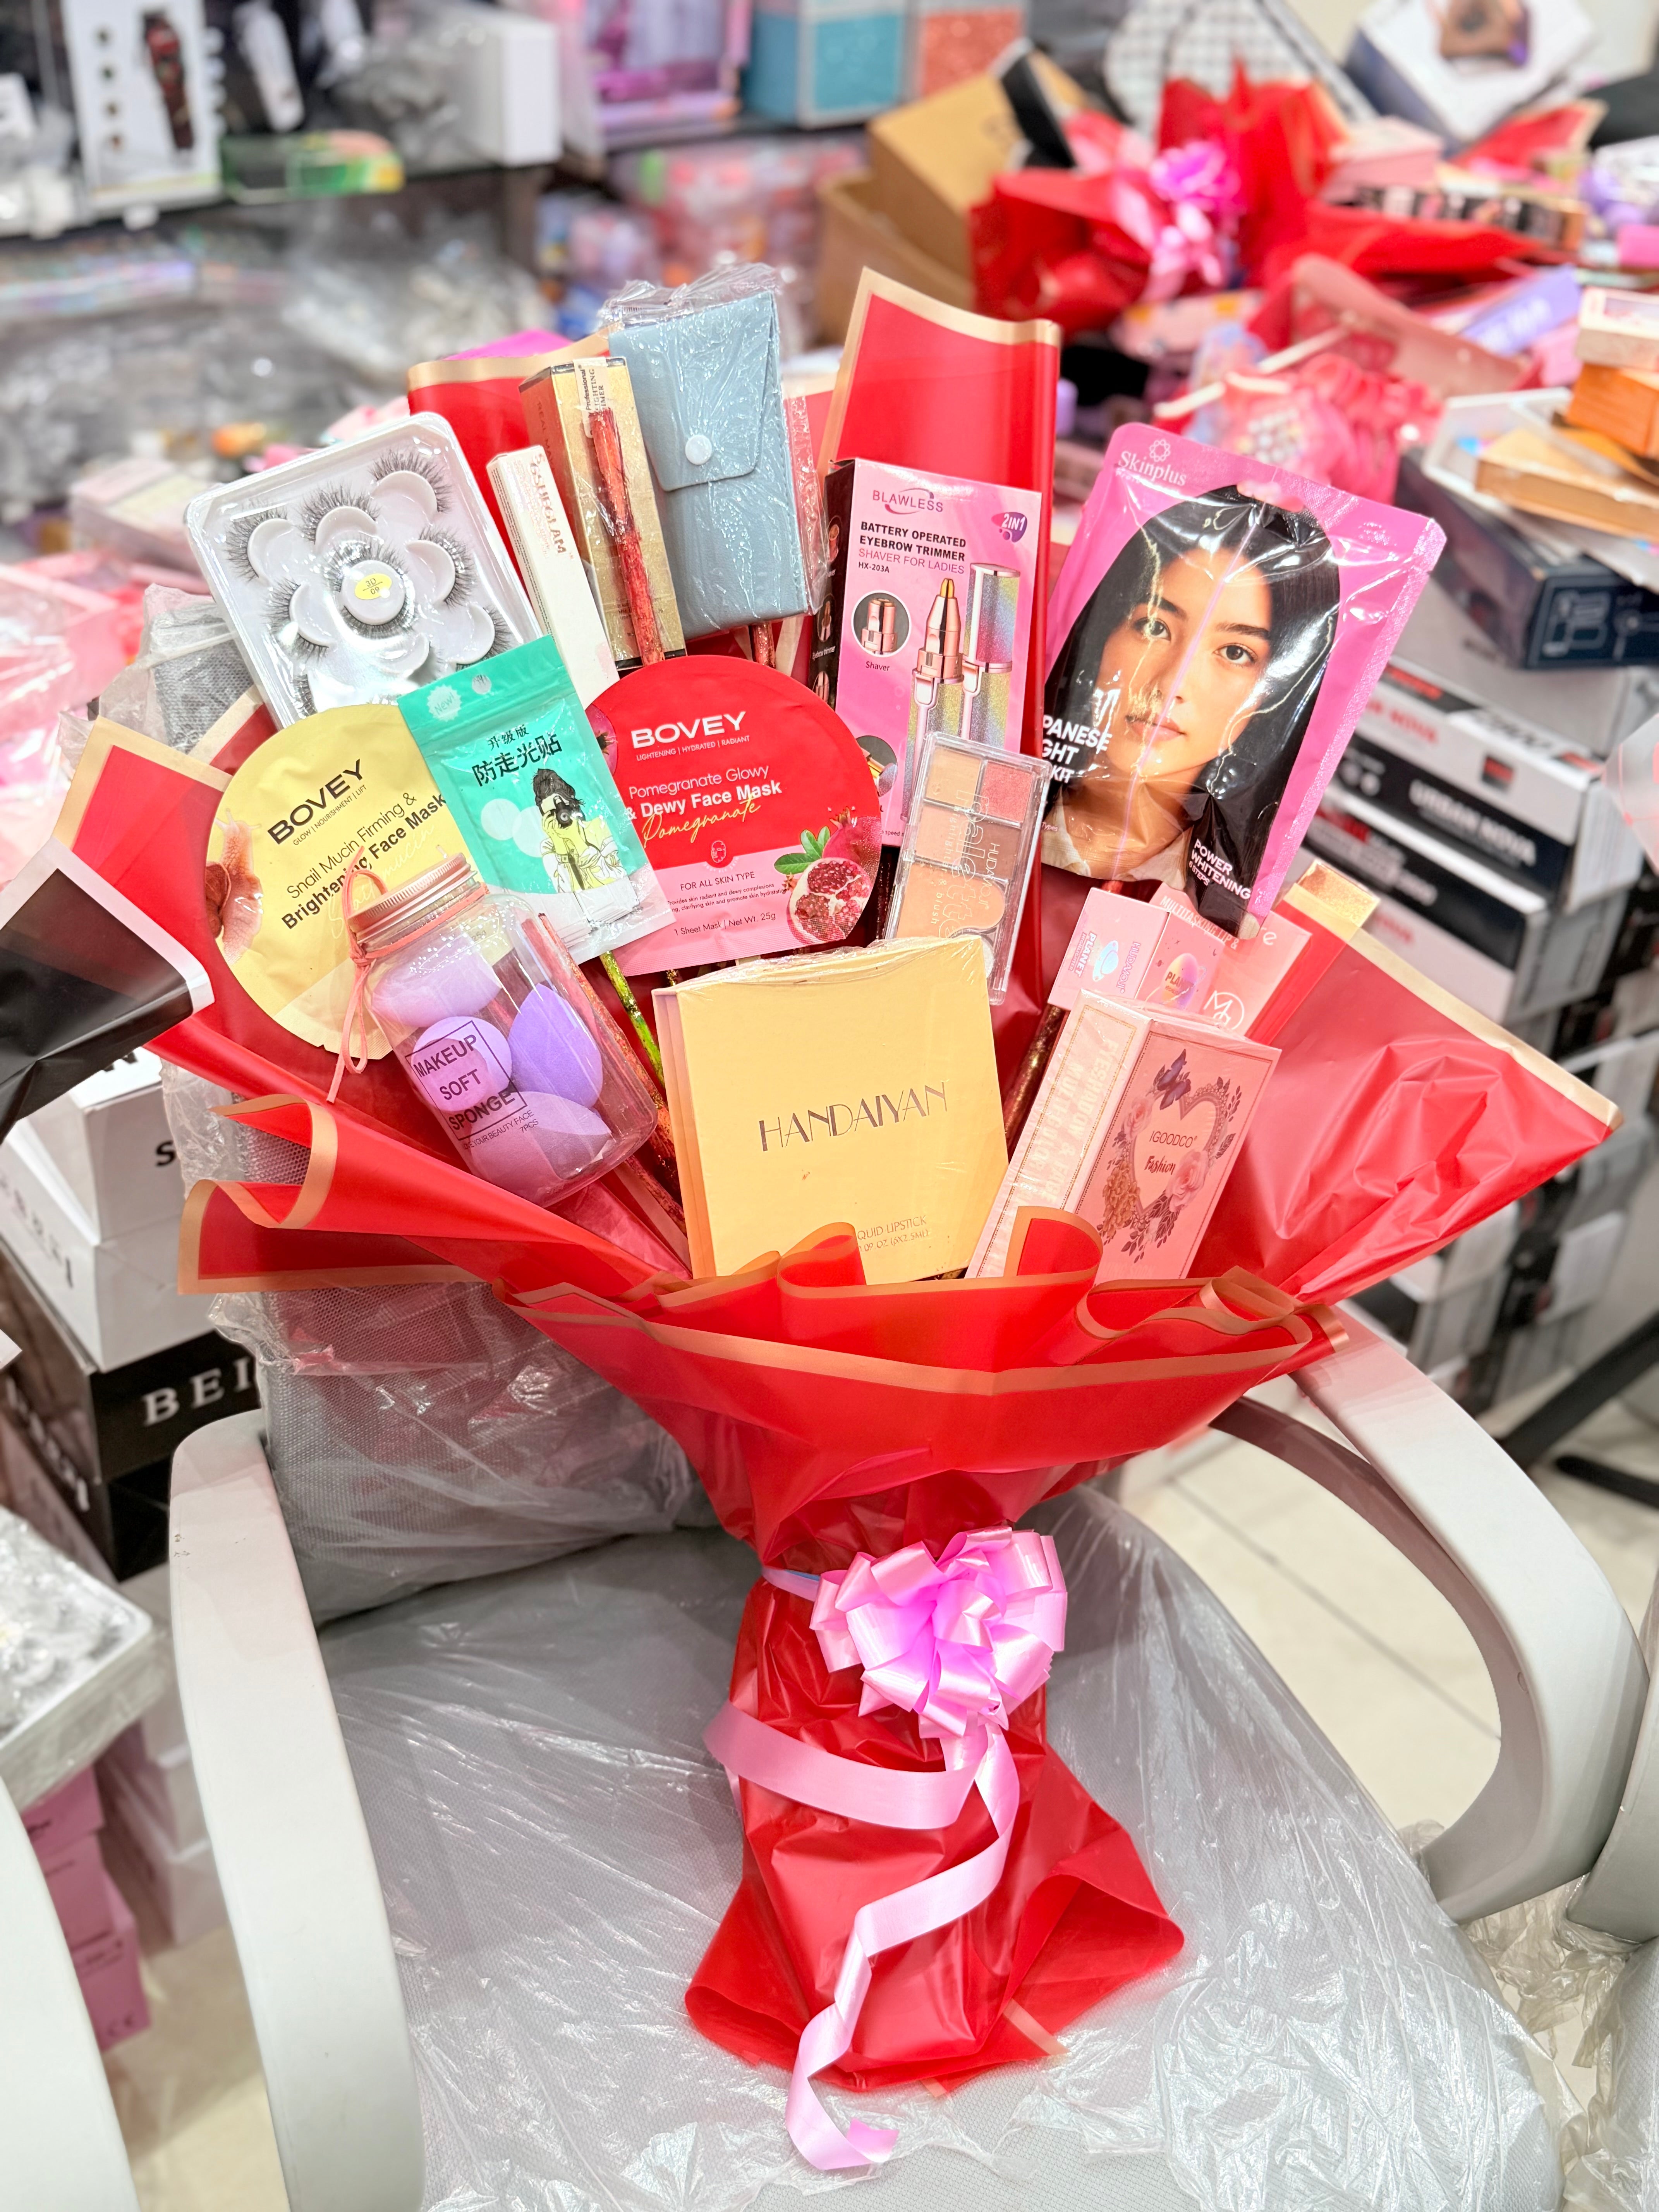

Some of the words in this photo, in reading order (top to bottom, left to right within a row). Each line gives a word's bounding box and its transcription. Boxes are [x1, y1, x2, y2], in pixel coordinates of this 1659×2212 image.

[580, 369, 591, 410] Professional
[1118, 451, 1187, 486] Skinplus
[873, 490, 943, 512] BLAWLESS
[861, 521, 908, 538] BATTERY
[912, 531, 966, 548] OPERATED
[1001, 513, 1025, 531] 2IN1
[859, 548, 900, 563] SHAVER
[903, 556, 925, 568] FOR
[928, 560, 964, 574] LADIES
[860, 535, 912, 553] EYEBROW
[916, 545, 965, 562] TRIMMER
[366, 578, 376, 587] 3D
[859, 562, 890, 573] HX-203A
[866, 661, 890, 672] Shaver
[487, 724, 529, 750] 升级版
[631, 711, 746, 749] BOVEY
[1043, 715, 1113, 751] PANESE
[472, 734, 562, 787] 防走光贴
[637, 748, 677, 761] LIGHTENING
[682, 741, 716, 753] HYDRATED
[721, 735, 750, 747] RADIANT
[1042, 739, 1079, 764] GHT
[629, 773, 722, 799] Pomegranate
[726, 766, 769, 782] Glowy
[1051, 765, 1075, 783] KIT
[268, 759, 363, 845] BOVEY
[293, 831, 311, 846] GLOW
[315, 796, 353, 829] NOURISHMENT
[356, 785, 367, 796] LIFT
[626, 807, 637, 820] &
[640, 799, 686, 818] Dewy
[691, 791, 732, 809] Face
[736, 780, 782, 801] Mask
[368, 828, 407, 860] Face
[405, 793, 447, 830] Mask
[641, 796, 761, 848] Pomegranate
[287, 867, 322, 899] Snail
[319, 839, 360, 874] Mucin
[357, 803, 405, 843] Firming
[403, 793, 417, 806] &
[1194, 839, 1233, 876] POWER
[680, 883, 697, 891] FOR
[699, 879, 713, 888] ALL
[715, 875, 733, 885] SKIN
[736, 871, 755, 881] TYPE
[743, 883, 774, 893] complexions
[1191, 849, 1251, 900] WHITENING
[1192, 866, 1210, 886] STEPS
[682, 902, 704, 911] clarifying
[727, 895, 747, 903] promote
[931, 893, 943, 924] blush
[681, 926, 701, 935] Sheet
[703, 921, 721, 931] Mask
[728, 919, 742, 927] Net
[760, 912, 776, 922] 25g
[1160, 896, 1219, 936] MULTITASKING
[1230, 938, 1240, 950] &
[1075, 931, 1097, 978] PLANET
[413, 1034, 476, 1077] MAKEUP
[440, 1068, 481, 1100] SOFT
[448, 1087, 515, 1130] SPONGE
[759, 1082, 947, 1151] HANDAIYAN
[473, 1135, 488, 1148] YOUR
[488, 1121, 514, 1139] BEAUTY
[514, 1110, 534, 1125] FACE
[519, 1119, 539, 1133] 7PCS
[1144, 1155, 1176, 1175] Fashion
[857, 1226, 883, 1240] QUID
[886, 1215, 926, 1233] LIPSTICK
